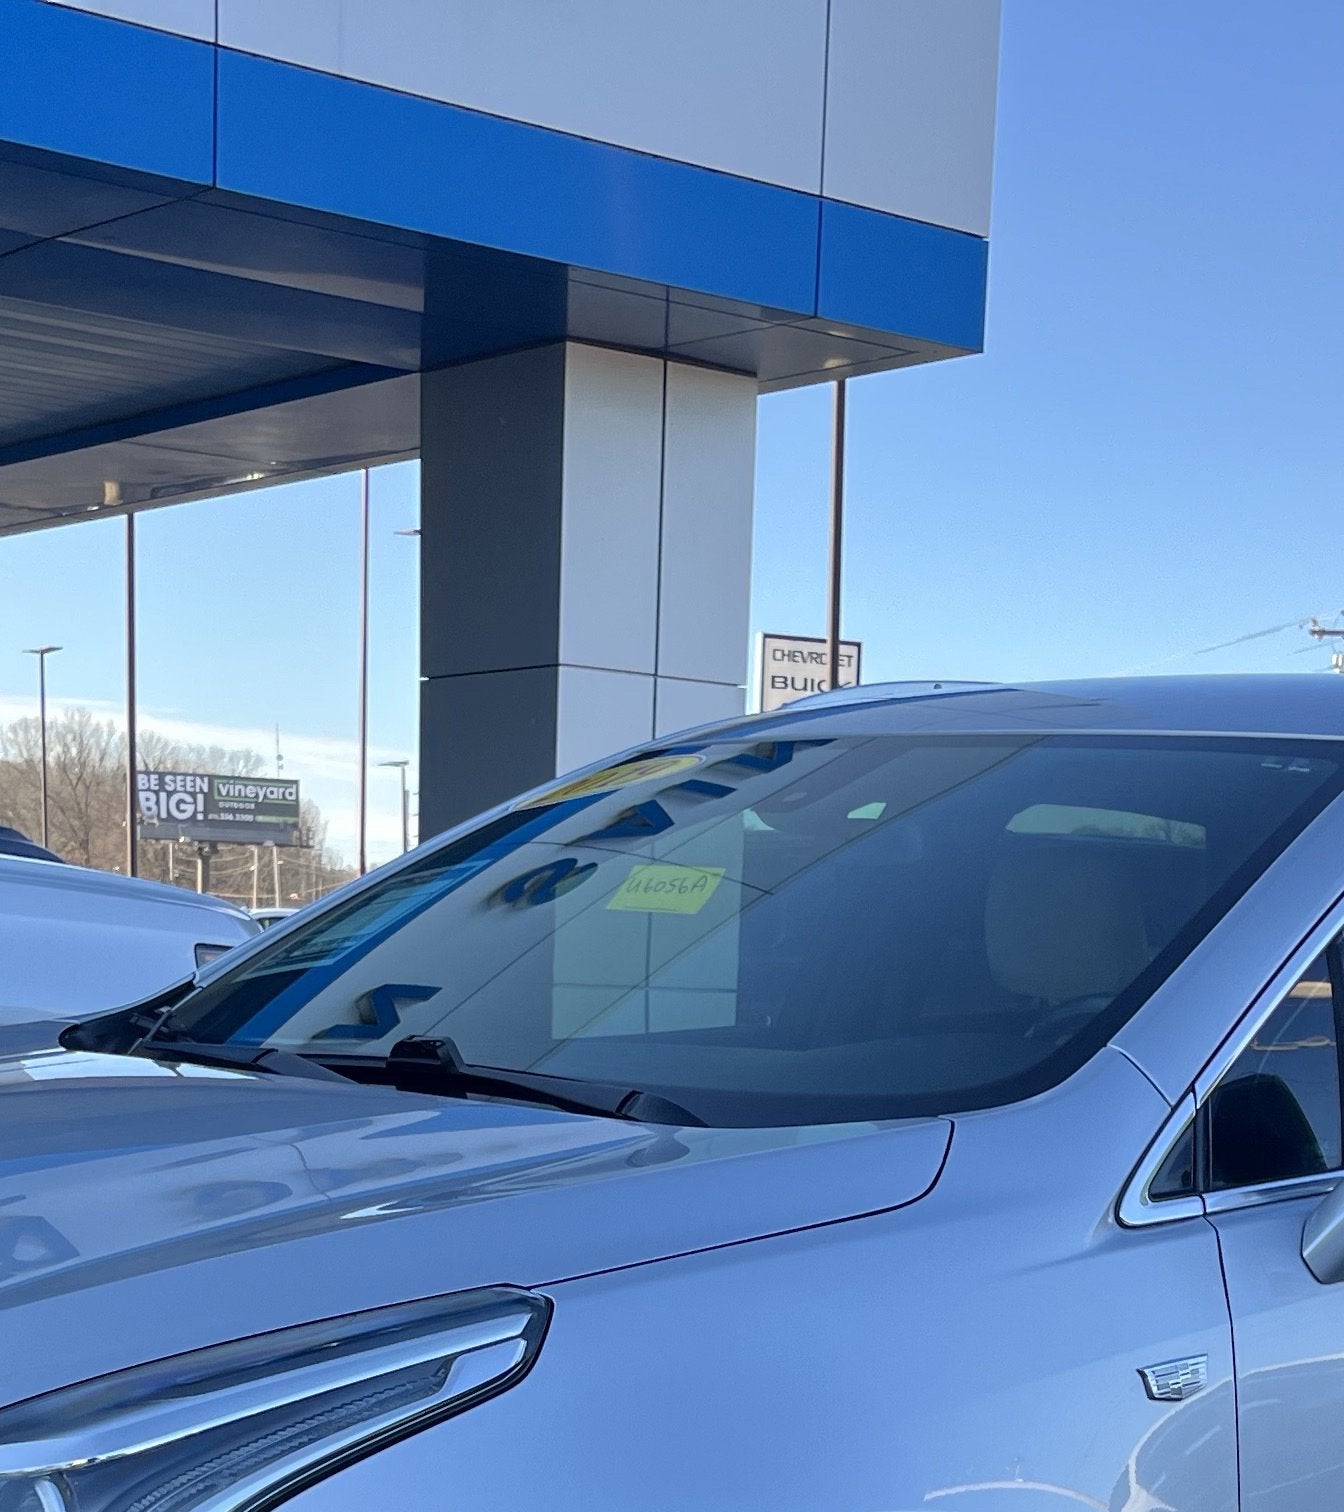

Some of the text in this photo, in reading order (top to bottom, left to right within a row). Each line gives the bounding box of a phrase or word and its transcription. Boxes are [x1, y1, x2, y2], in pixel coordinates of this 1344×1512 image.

[772, 648, 854, 668] CHEVROET
[137, 774, 209, 793] BE SEEN
[218, 781, 297, 802] vineyard
[138, 791, 205, 821] BIG!
